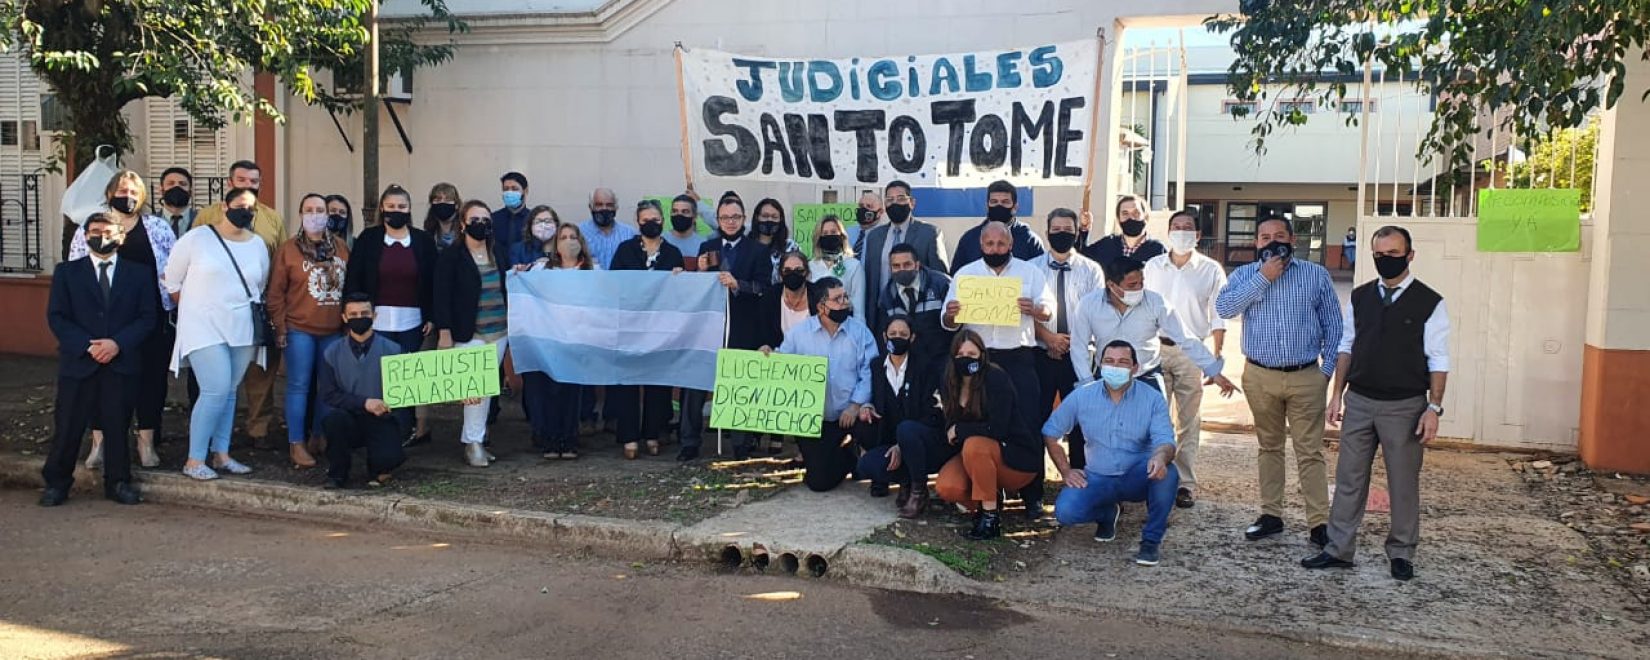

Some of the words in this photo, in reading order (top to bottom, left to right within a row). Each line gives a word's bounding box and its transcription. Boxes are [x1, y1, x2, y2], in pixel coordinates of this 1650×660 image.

[702, 95, 926, 183] SANTO
[931, 97, 1085, 178] TOME
[959, 278, 1018, 299] SANTO
[959, 303, 1019, 322] TOME
[387, 350, 495, 383] REAJUSTE
[721, 358, 826, 383] LUCHEMOS
[387, 376, 497, 406] SALARIAL
[715, 384, 816, 409] DIGNIDAD
[713, 406, 726, 427] Y
[732, 407, 823, 434] DERECHOS
